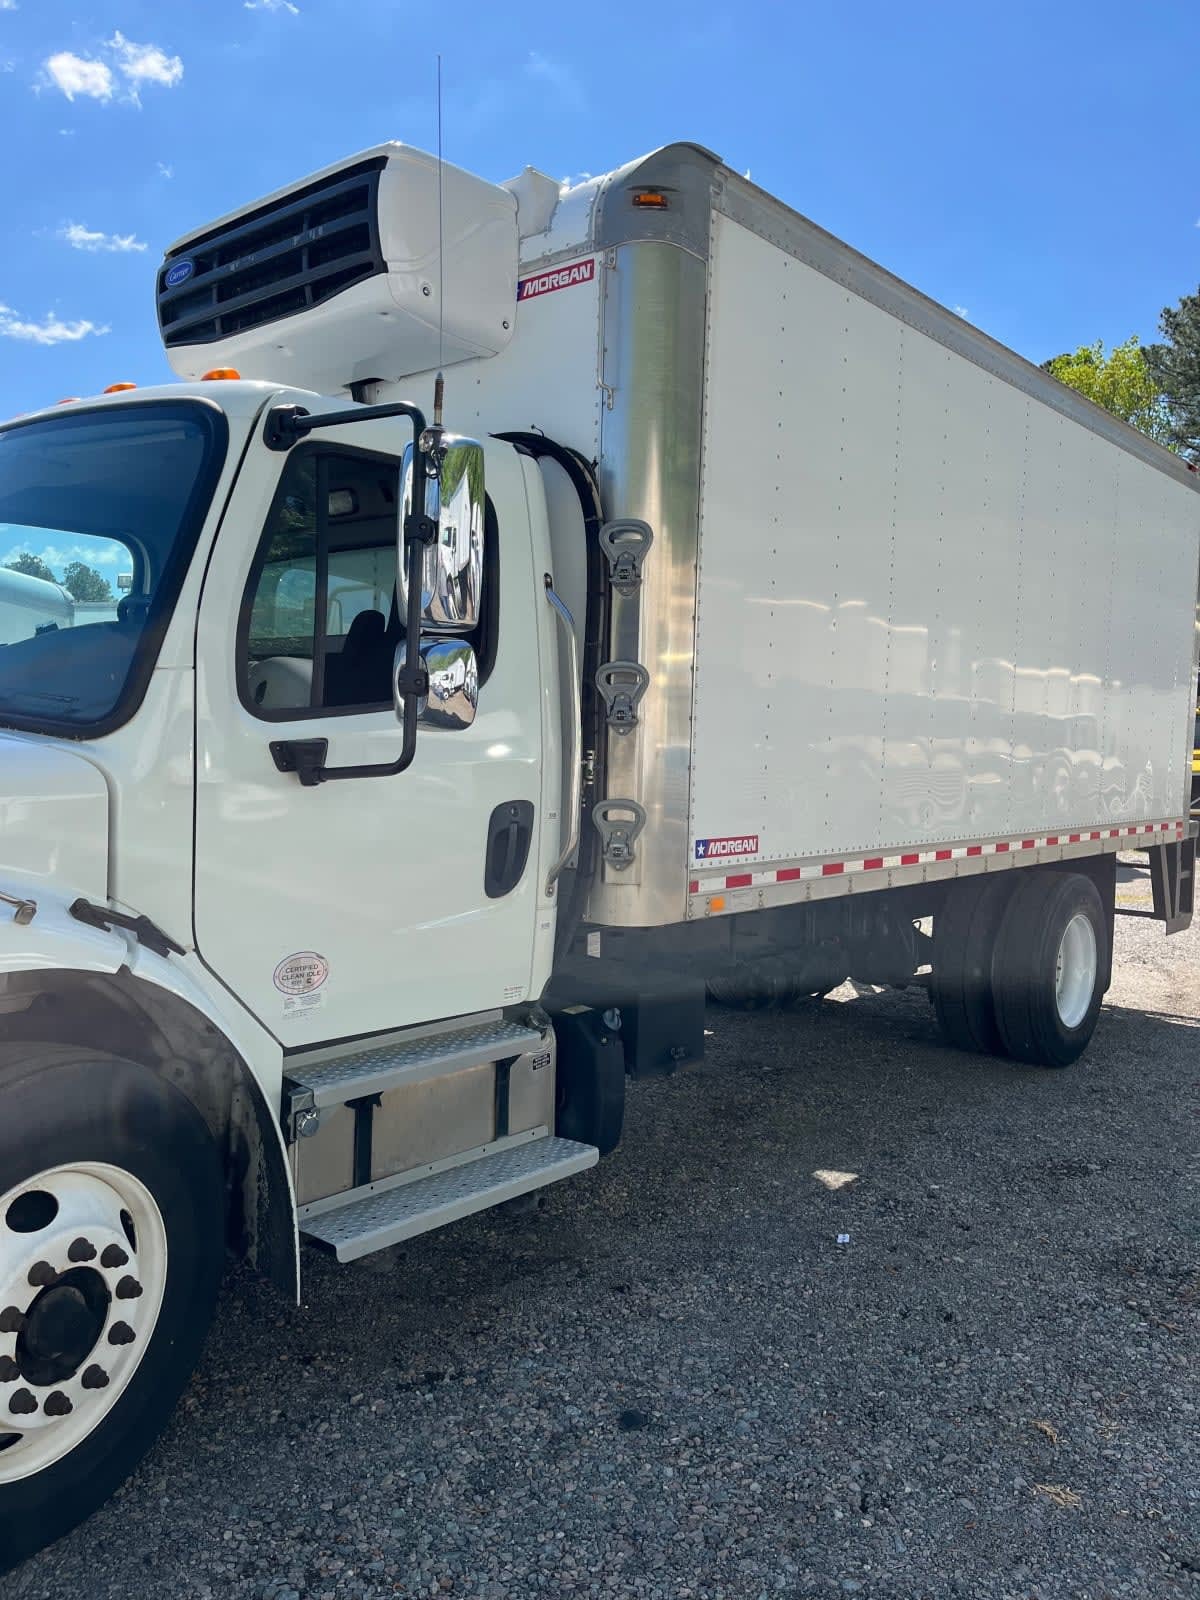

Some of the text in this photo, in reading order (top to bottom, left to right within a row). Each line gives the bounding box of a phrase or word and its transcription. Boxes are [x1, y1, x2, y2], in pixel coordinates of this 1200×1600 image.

[523, 263, 592, 297] MORGAN
[708, 839, 757, 855] MORGAN
[285, 964, 319, 974] CERTIFIED
[281, 973, 305, 981] CLEAN
